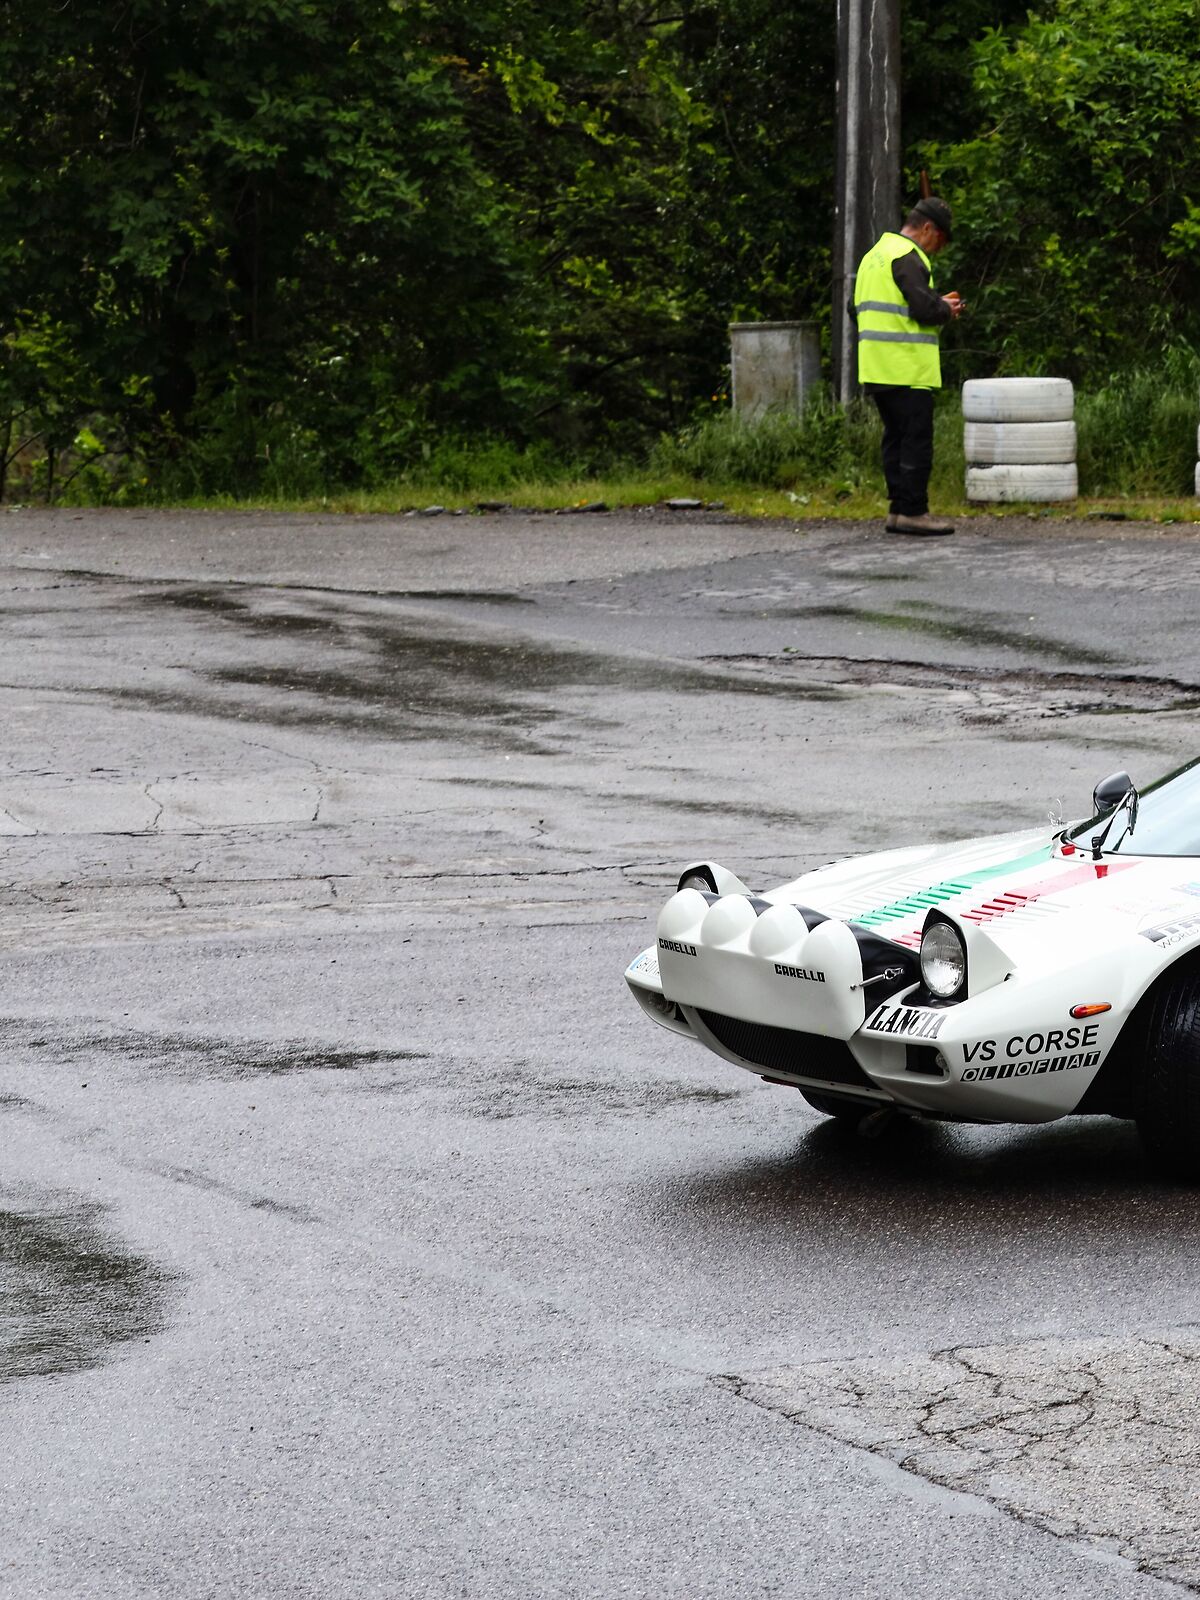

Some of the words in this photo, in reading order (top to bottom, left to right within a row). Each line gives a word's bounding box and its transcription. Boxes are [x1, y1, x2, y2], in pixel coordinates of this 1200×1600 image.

[659, 938, 697, 957] CARELLO
[774, 963, 826, 983] CARELLO
[866, 1005, 949, 1040] LANCIA
[962, 1040, 997, 1063] VS
[1005, 1024, 1100, 1058] CORSE
